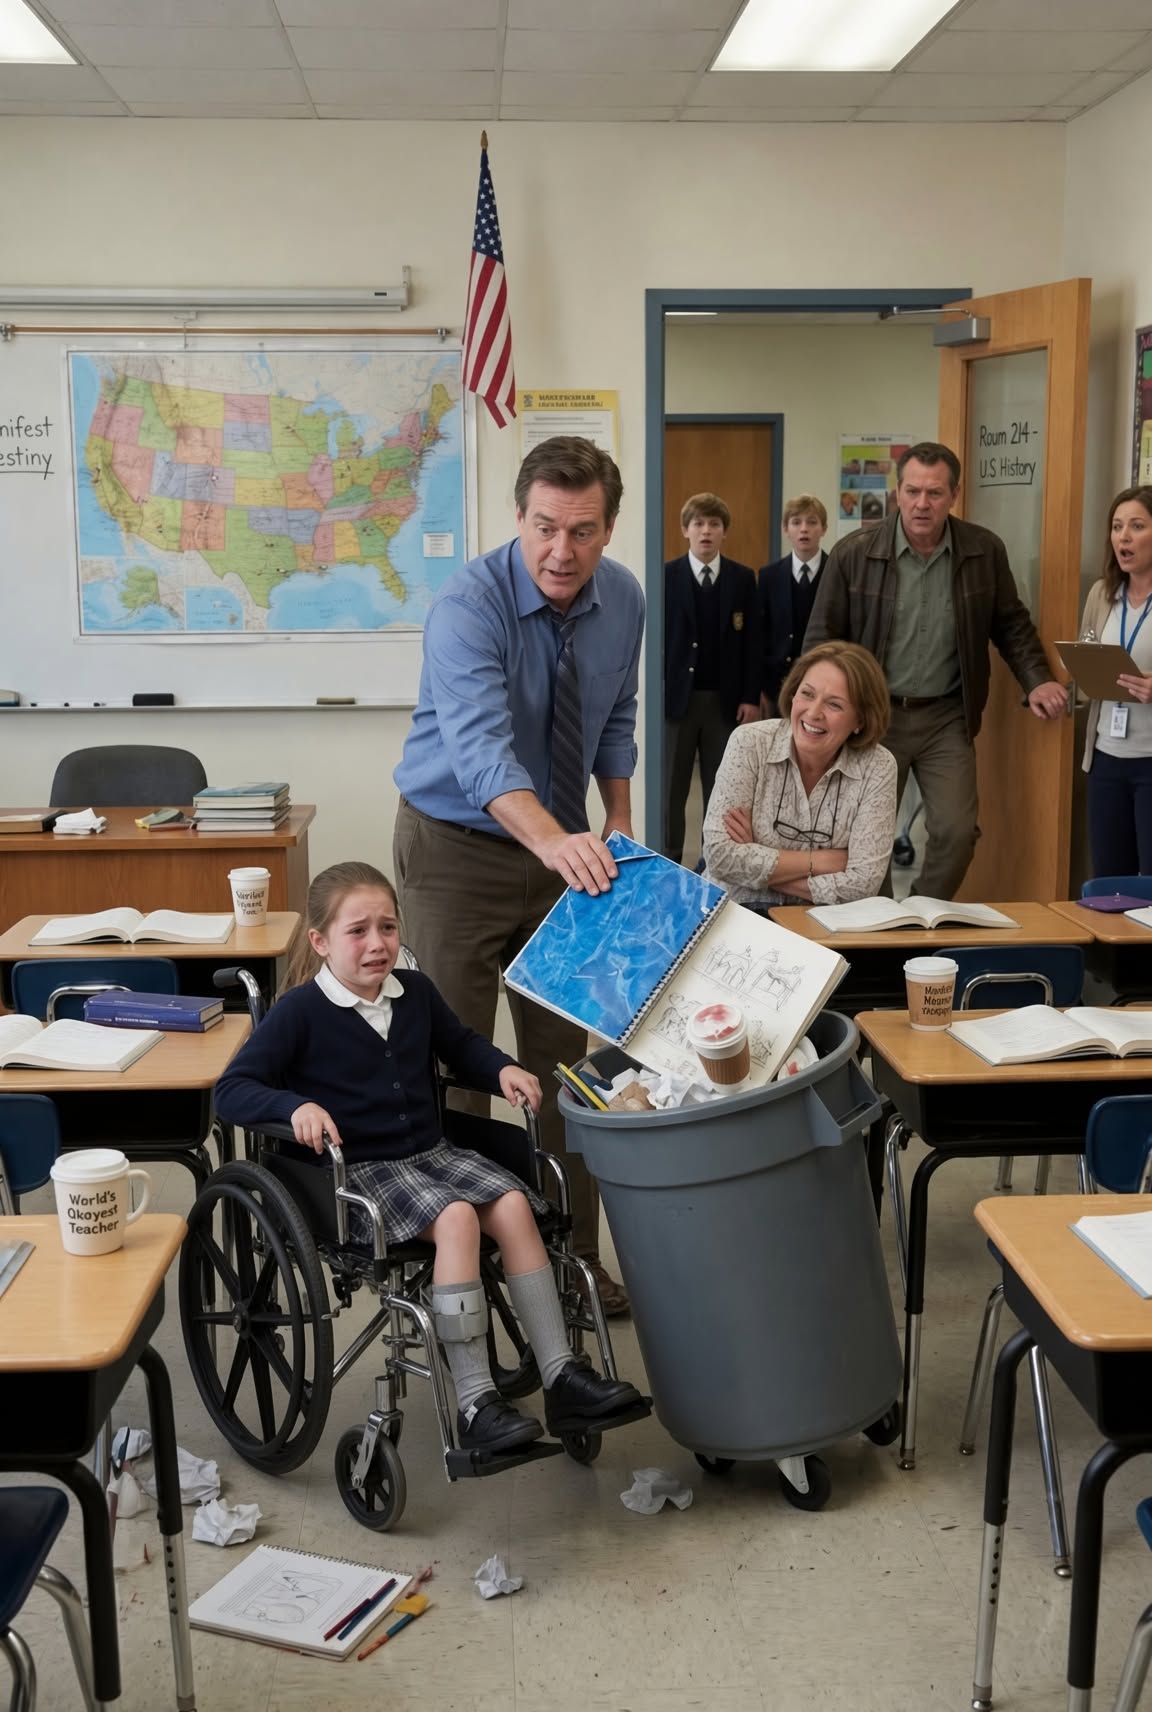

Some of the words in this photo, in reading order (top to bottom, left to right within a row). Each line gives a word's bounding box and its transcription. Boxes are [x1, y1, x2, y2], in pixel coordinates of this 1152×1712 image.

[1000, 456, 1036, 485] History
[69, 1190, 117, 1206] World's
[69, 1220, 120, 1235] Teacher
